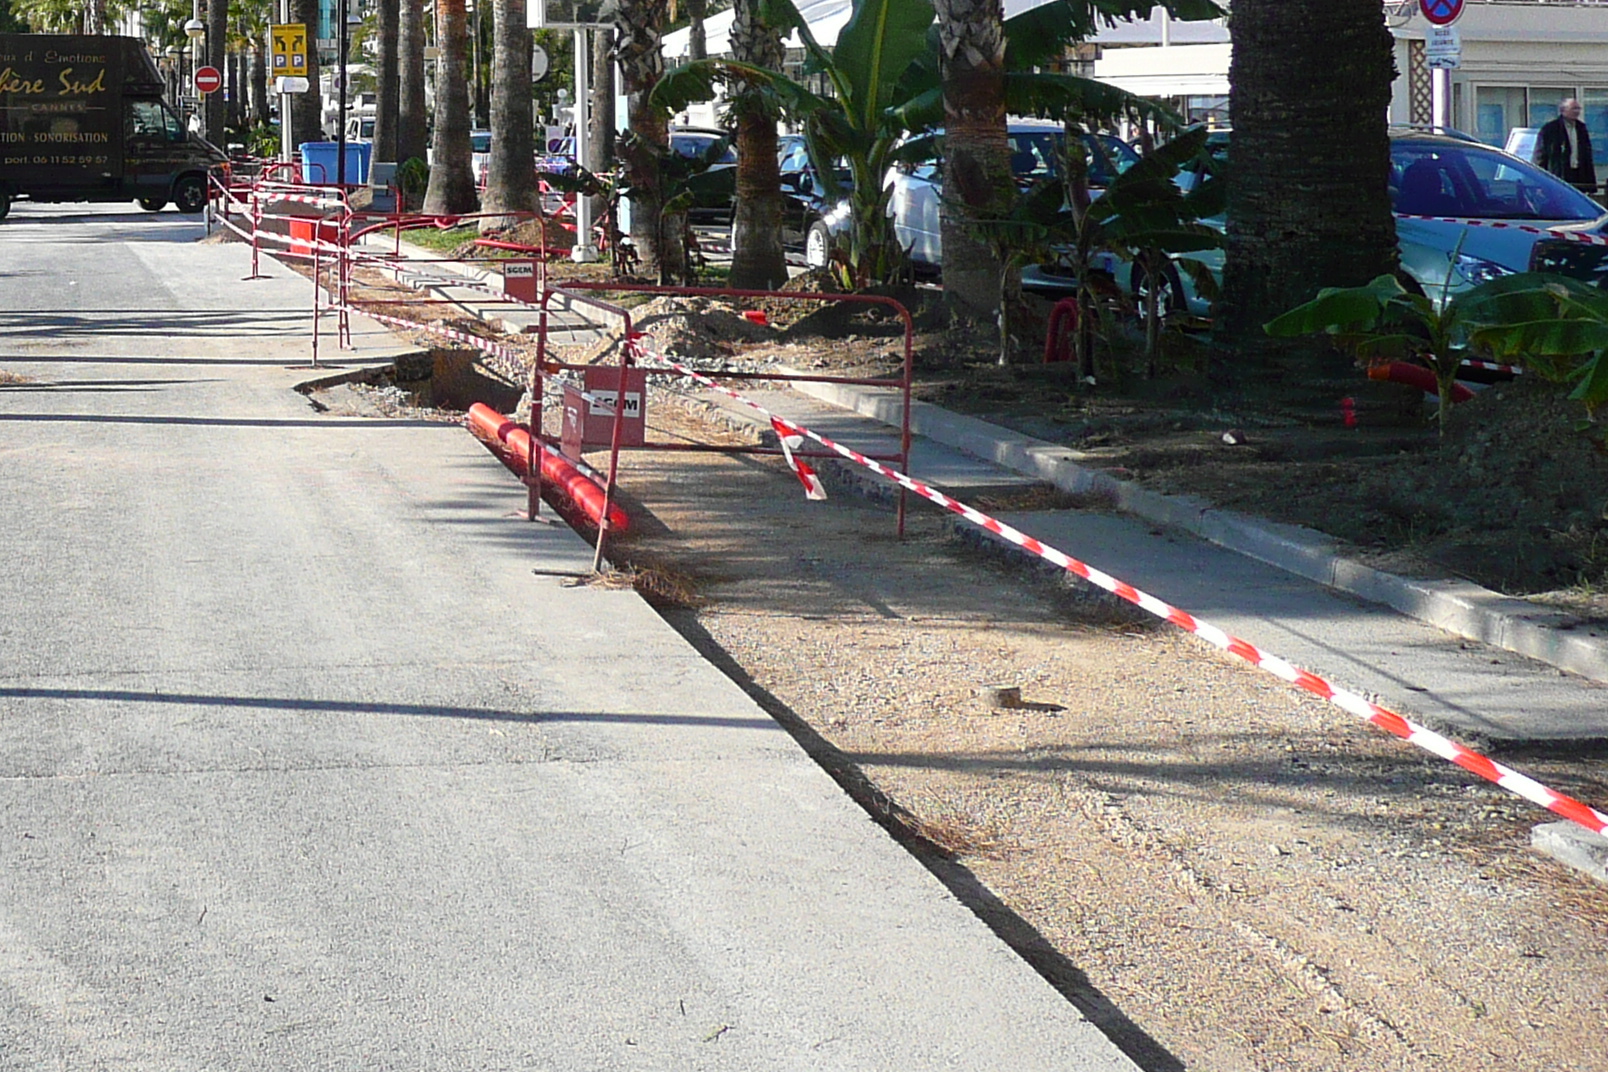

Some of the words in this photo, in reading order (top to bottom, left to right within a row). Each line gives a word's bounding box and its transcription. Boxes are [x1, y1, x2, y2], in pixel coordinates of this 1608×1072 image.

[276, 56, 284, 66] P
[294, 56, 302, 66] P
[58, 68, 106, 95] Sud
[31, 103, 85, 113] CANNES
[34, 132, 109, 143] SONORISATION
